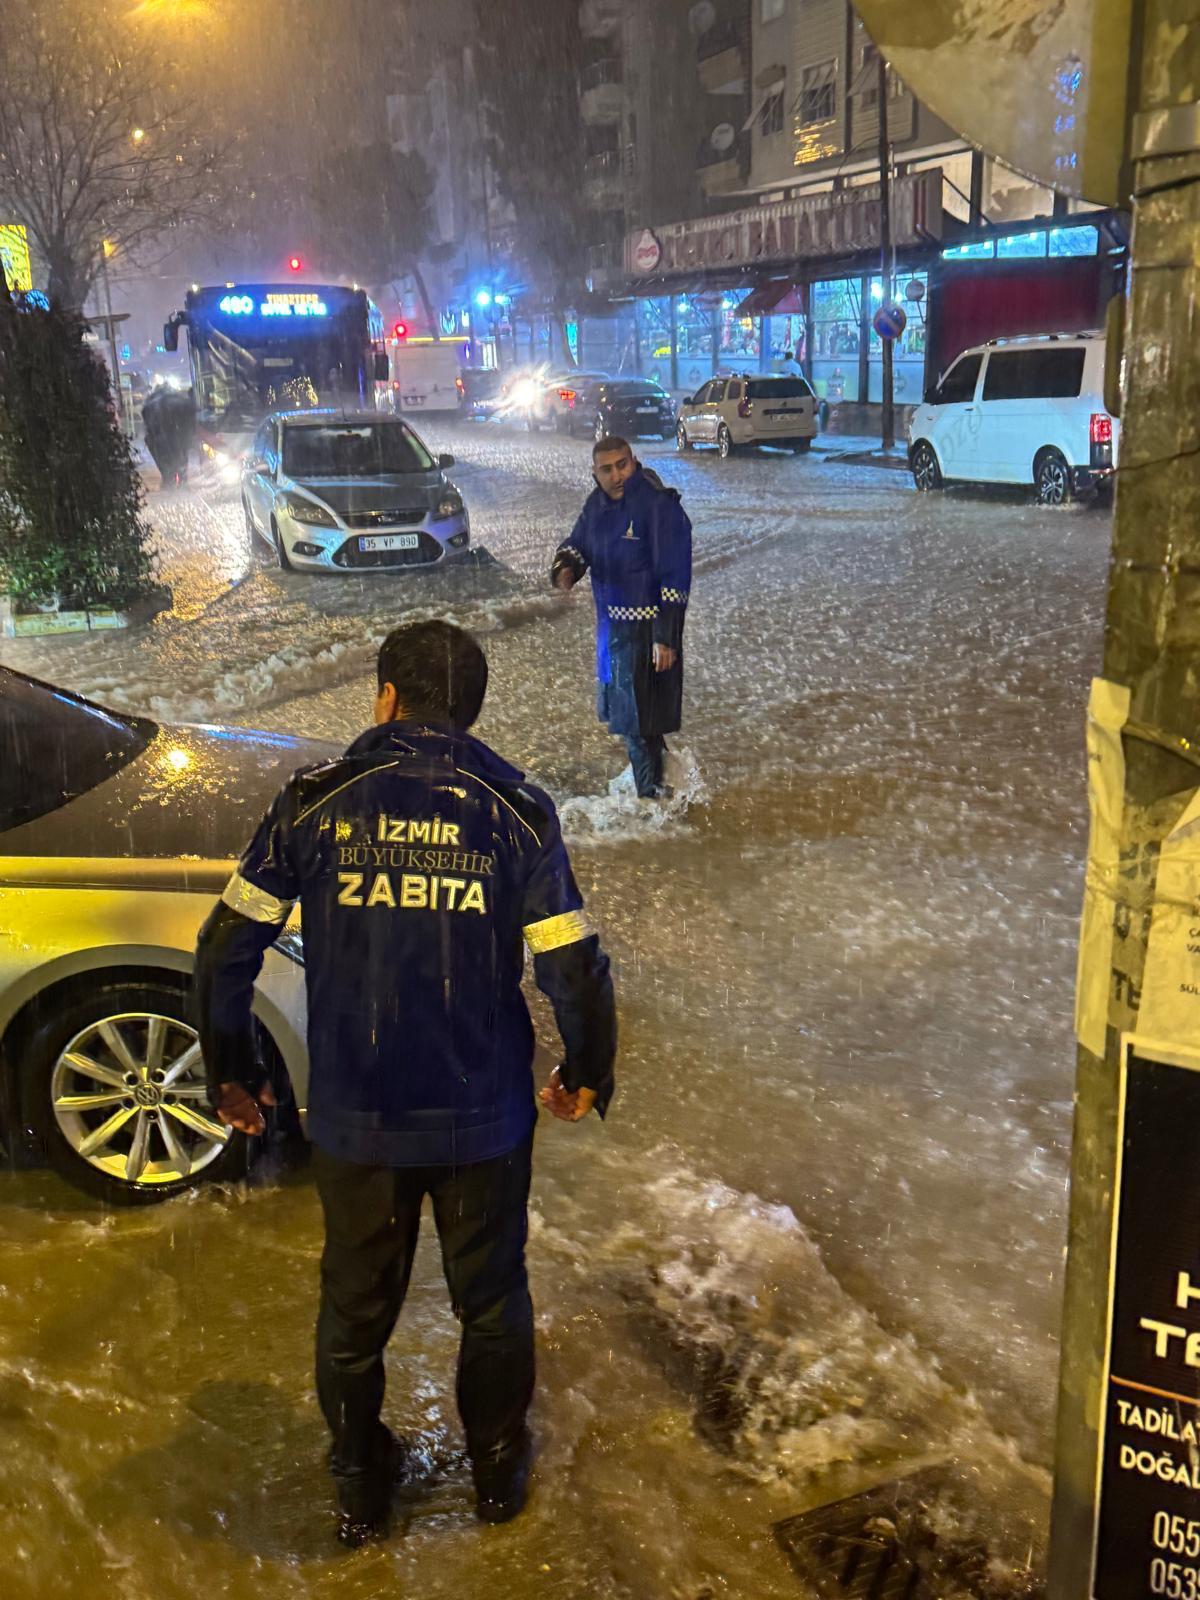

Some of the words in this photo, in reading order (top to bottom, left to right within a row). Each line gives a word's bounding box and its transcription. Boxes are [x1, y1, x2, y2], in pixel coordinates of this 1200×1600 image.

[377, 813, 460, 846] İZMİR
[337, 842, 494, 876] BÜYÜKŞEHİR
[338, 872, 487, 914] ZABITA
[1150, 1557, 1200, 1600] 053
